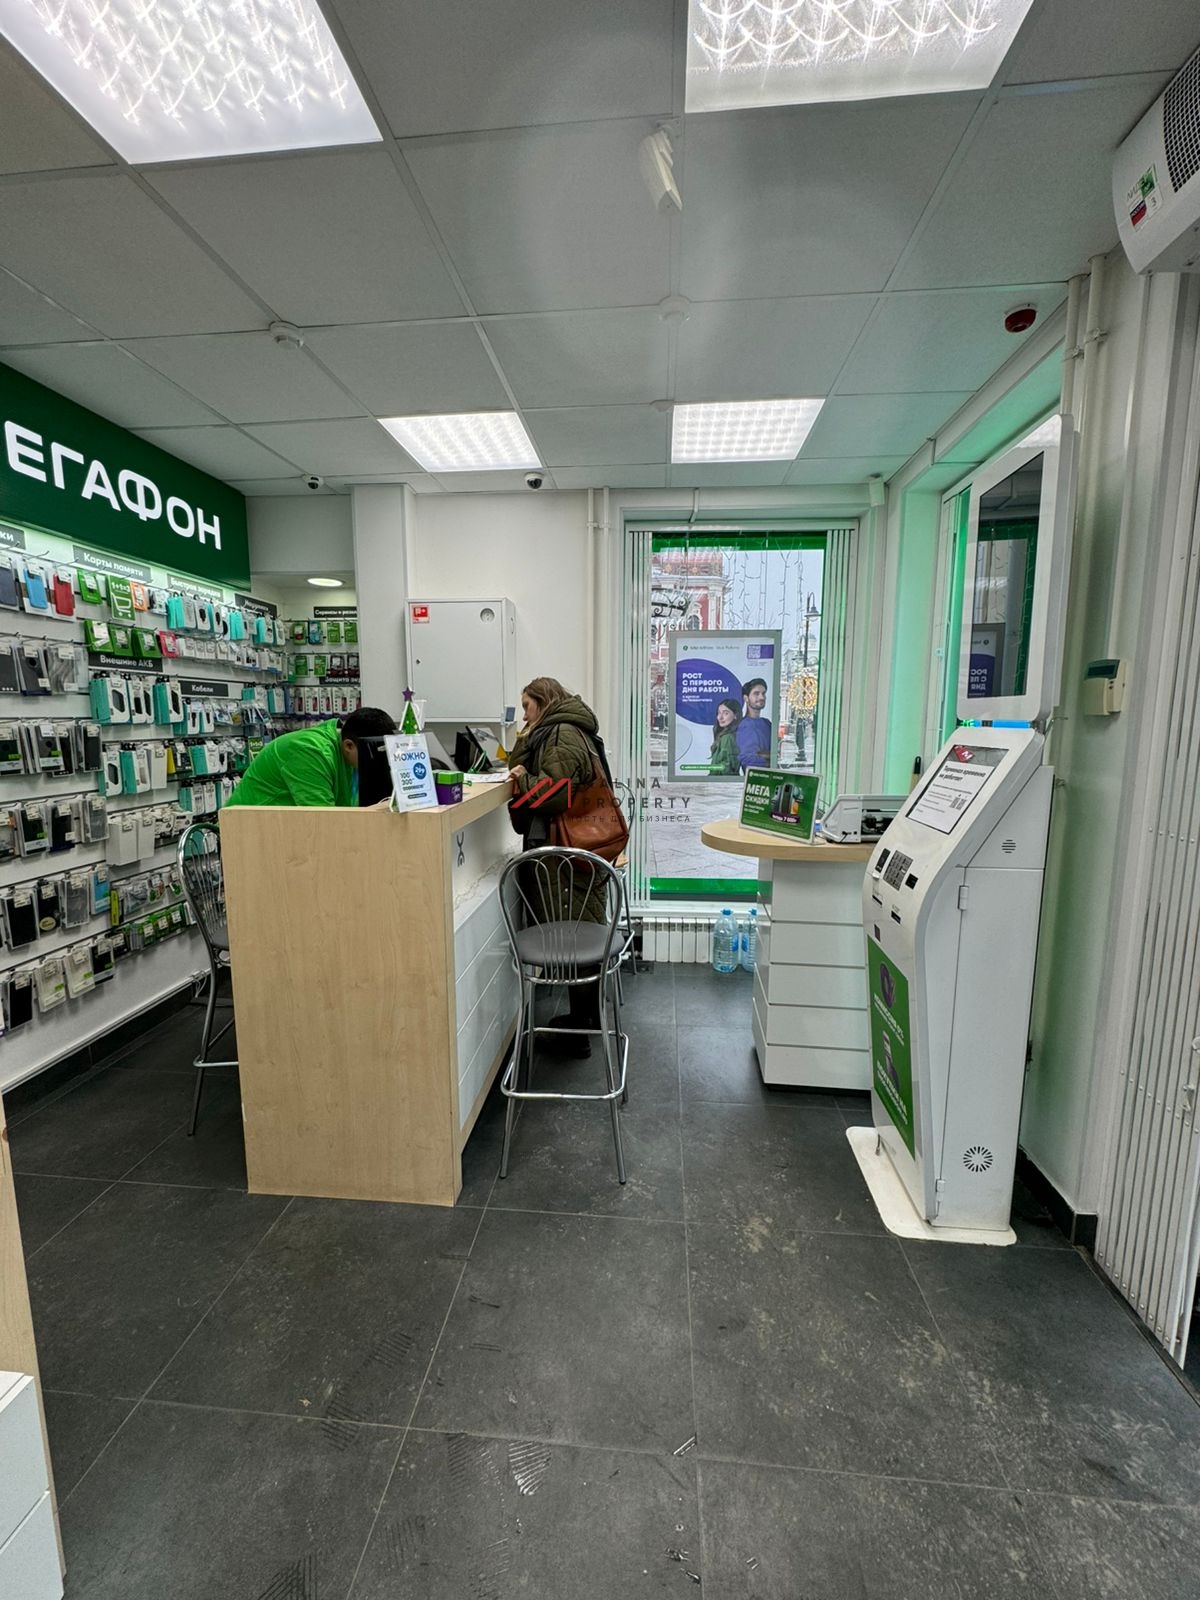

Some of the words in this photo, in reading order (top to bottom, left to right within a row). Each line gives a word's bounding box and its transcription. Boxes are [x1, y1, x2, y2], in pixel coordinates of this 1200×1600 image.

[4, 420, 222, 550] ЕГАФОН
[83, 552, 113, 568] Карты
[113, 563, 144, 577] памяти
[100, 654, 137, 667] Внешние
[138, 659, 154, 668] АКБ
[191, 684, 214, 693] Кабели
[393, 751, 426, 762] МОЖНО
[746, 783, 770, 797] МЕГА
[745, 794, 770, 805] СКИДКИ
